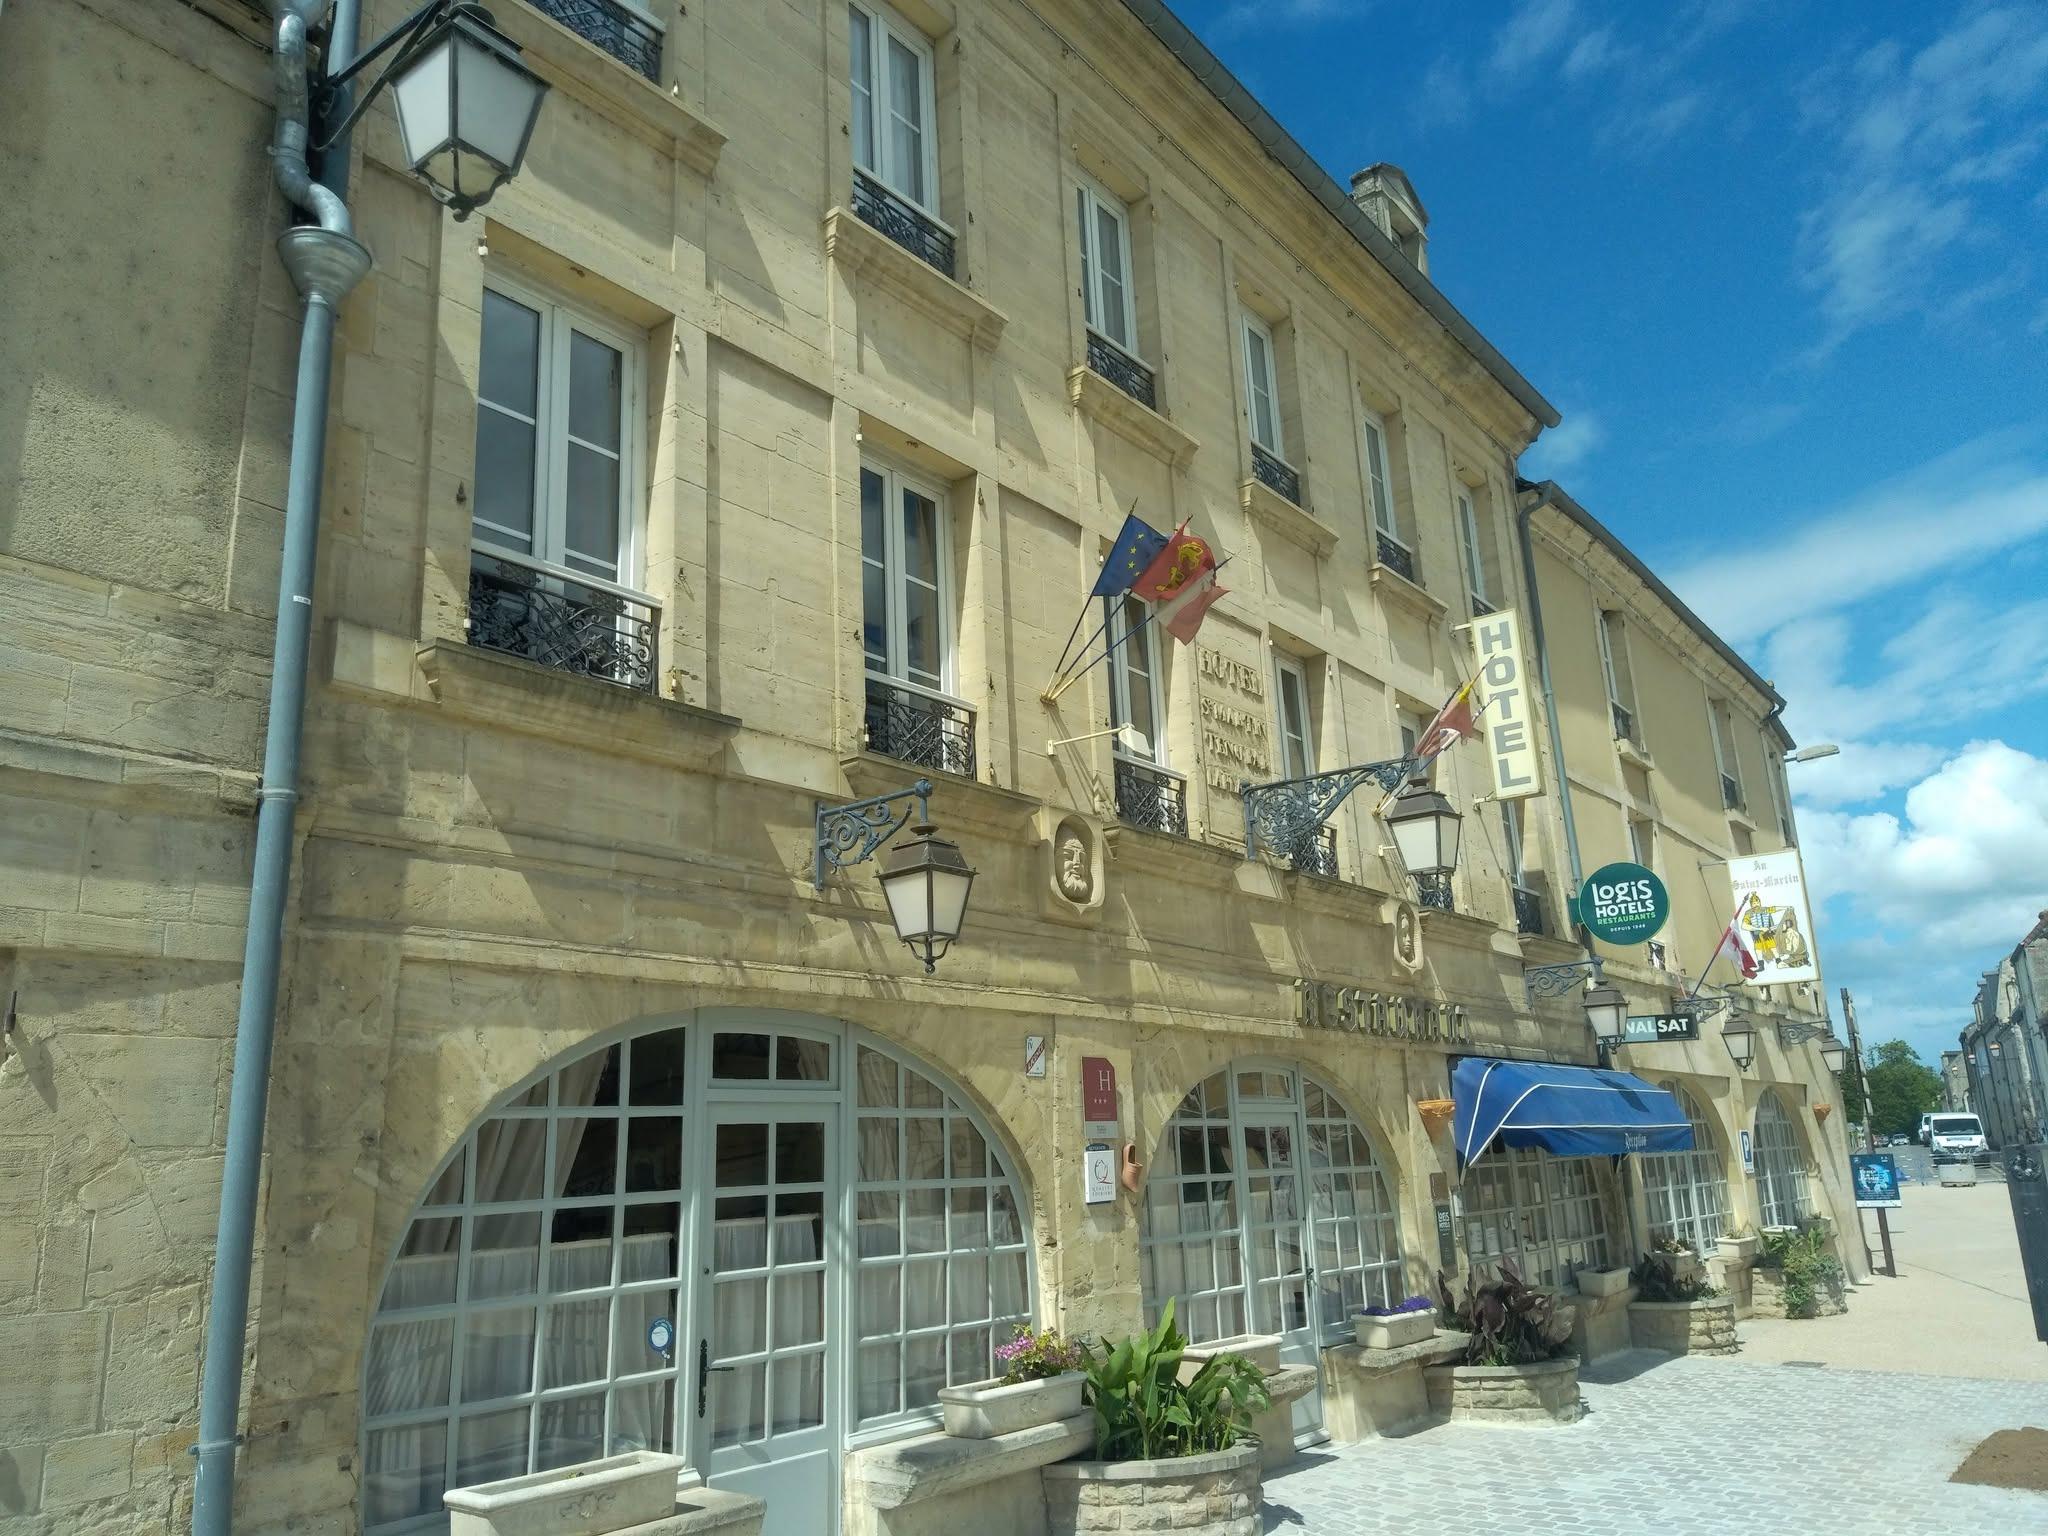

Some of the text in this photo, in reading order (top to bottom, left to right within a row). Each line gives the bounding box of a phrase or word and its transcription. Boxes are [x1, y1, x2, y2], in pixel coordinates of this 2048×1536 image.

[1480, 621, 1531, 788] HOTEL
[1595, 900, 1655, 918] HOTELS
[1597, 911, 1656, 925] RESTAURANTS
[1098, 1070, 1111, 1092] H
